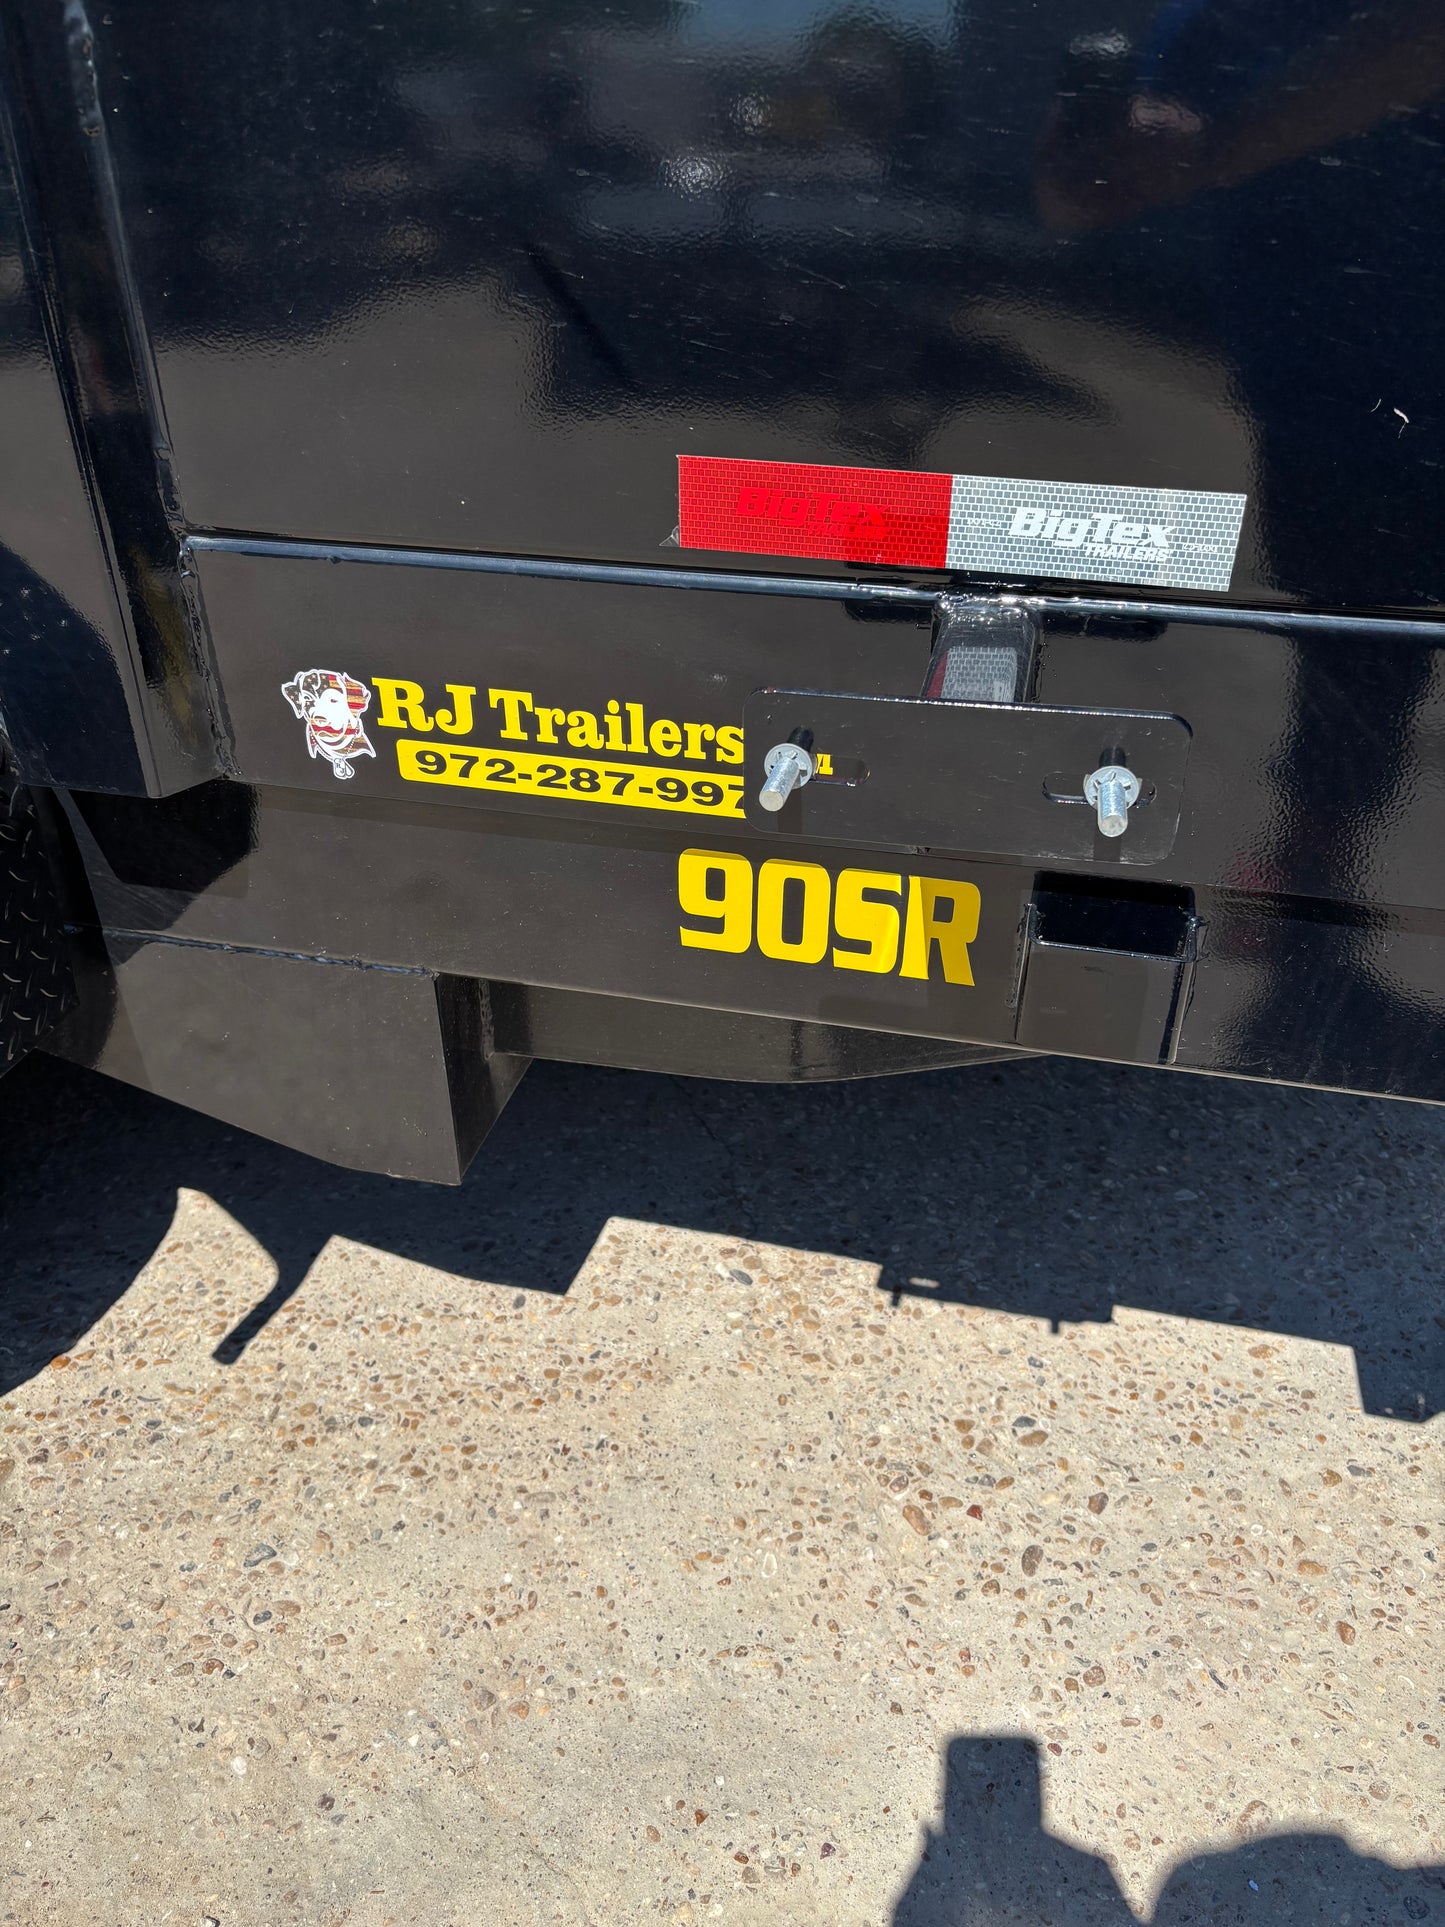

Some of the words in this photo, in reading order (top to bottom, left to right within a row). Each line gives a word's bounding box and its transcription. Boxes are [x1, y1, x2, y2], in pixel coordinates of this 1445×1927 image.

[736, 487, 889, 527] BigTex
[1008, 507, 1177, 548] BigTex
[1084, 542, 1171, 562] TRAILERS
[371, 677, 476, 736] RJ
[489, 688, 744, 765] Trailers
[678, 848, 982, 987] 90SR
